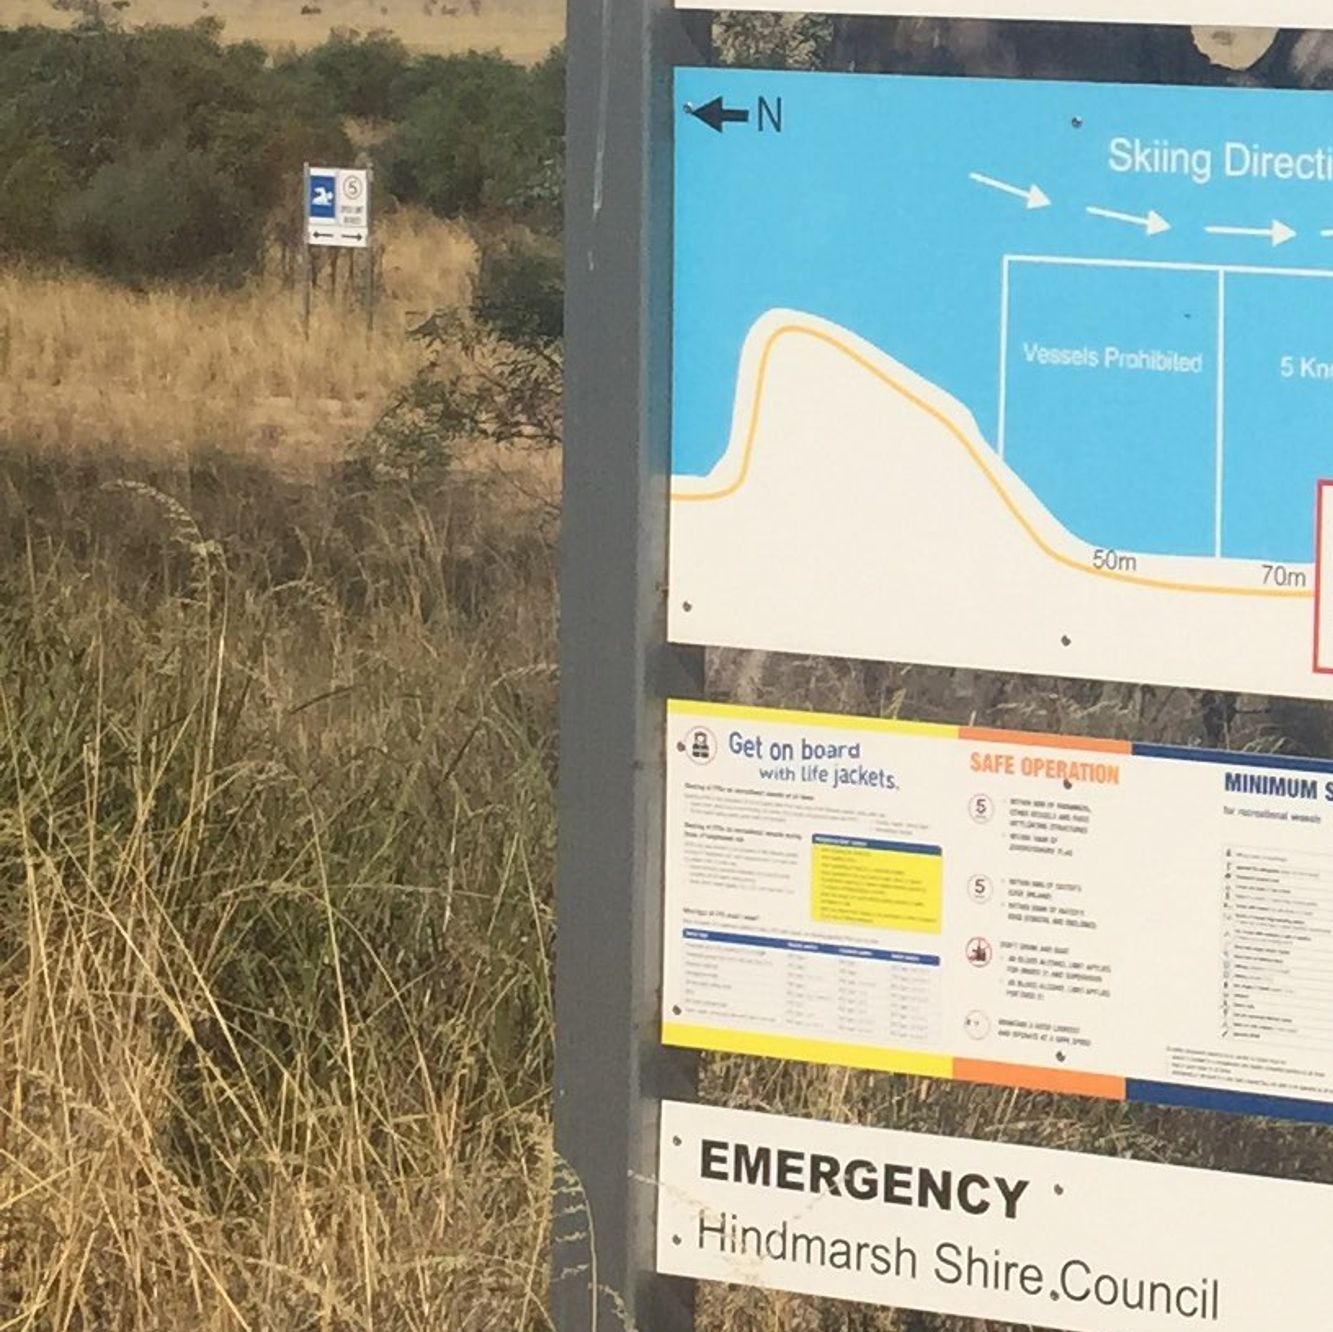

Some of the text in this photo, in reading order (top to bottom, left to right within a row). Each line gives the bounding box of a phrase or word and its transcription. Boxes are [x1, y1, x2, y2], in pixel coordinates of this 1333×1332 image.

[758, 96, 782, 132] N
[1108, 137, 1212, 183] Skiing
[1023, 342, 1203, 373] Vessels Prohibited
[1280, 356, 1294, 377] 5
[1092, 549, 1137, 571] 50m
[1262, 563, 1306, 587] 70m
[729, 731, 861, 761] Get on board
[759, 764, 900, 791] with life jackets.
[970, 751, 1120, 785] SAFE OPERATION
[1224, 771, 1317, 799] MINIMUM
[974, 798, 987, 815] 5
[974, 878, 986, 895] 5
[700, 1138, 1030, 1219] EMERGENCY
[698, 1209, 1219, 1321] Hindmarsh Shire Council
